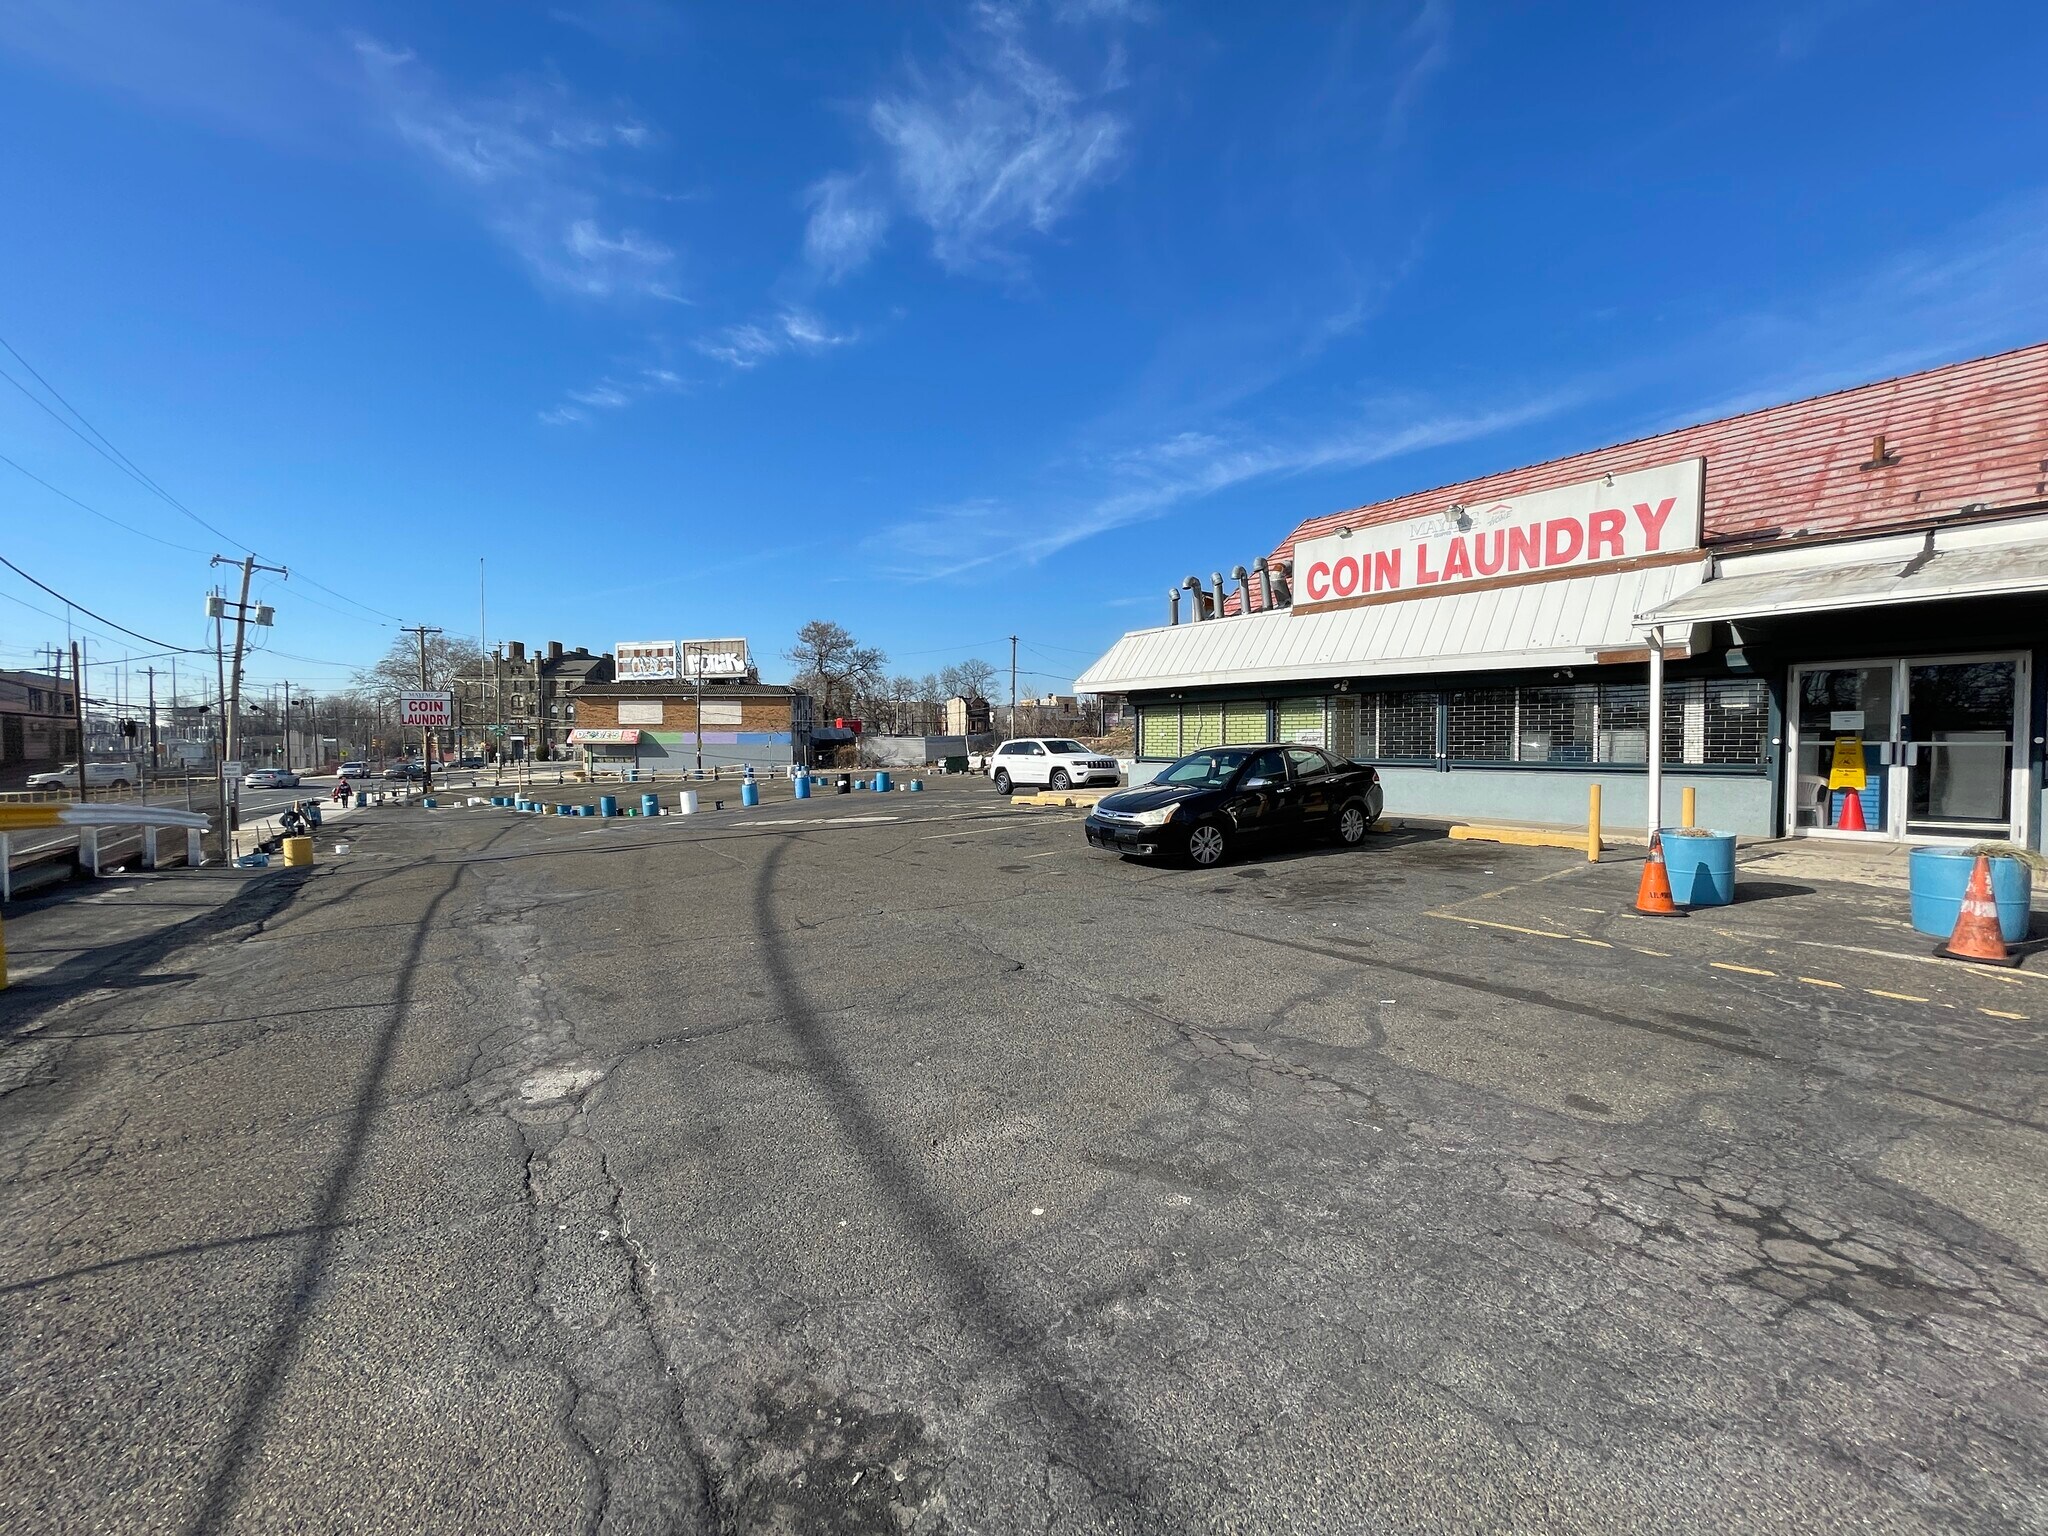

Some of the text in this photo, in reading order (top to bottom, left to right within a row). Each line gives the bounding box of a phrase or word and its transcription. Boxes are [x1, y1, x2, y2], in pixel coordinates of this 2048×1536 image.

[1410, 511, 1481, 538] MAYG
[1307, 497, 1677, 600] COIN LAUNDRY
[408, 701, 444, 712] COIN
[401, 714, 450, 725] LAUNDRY
